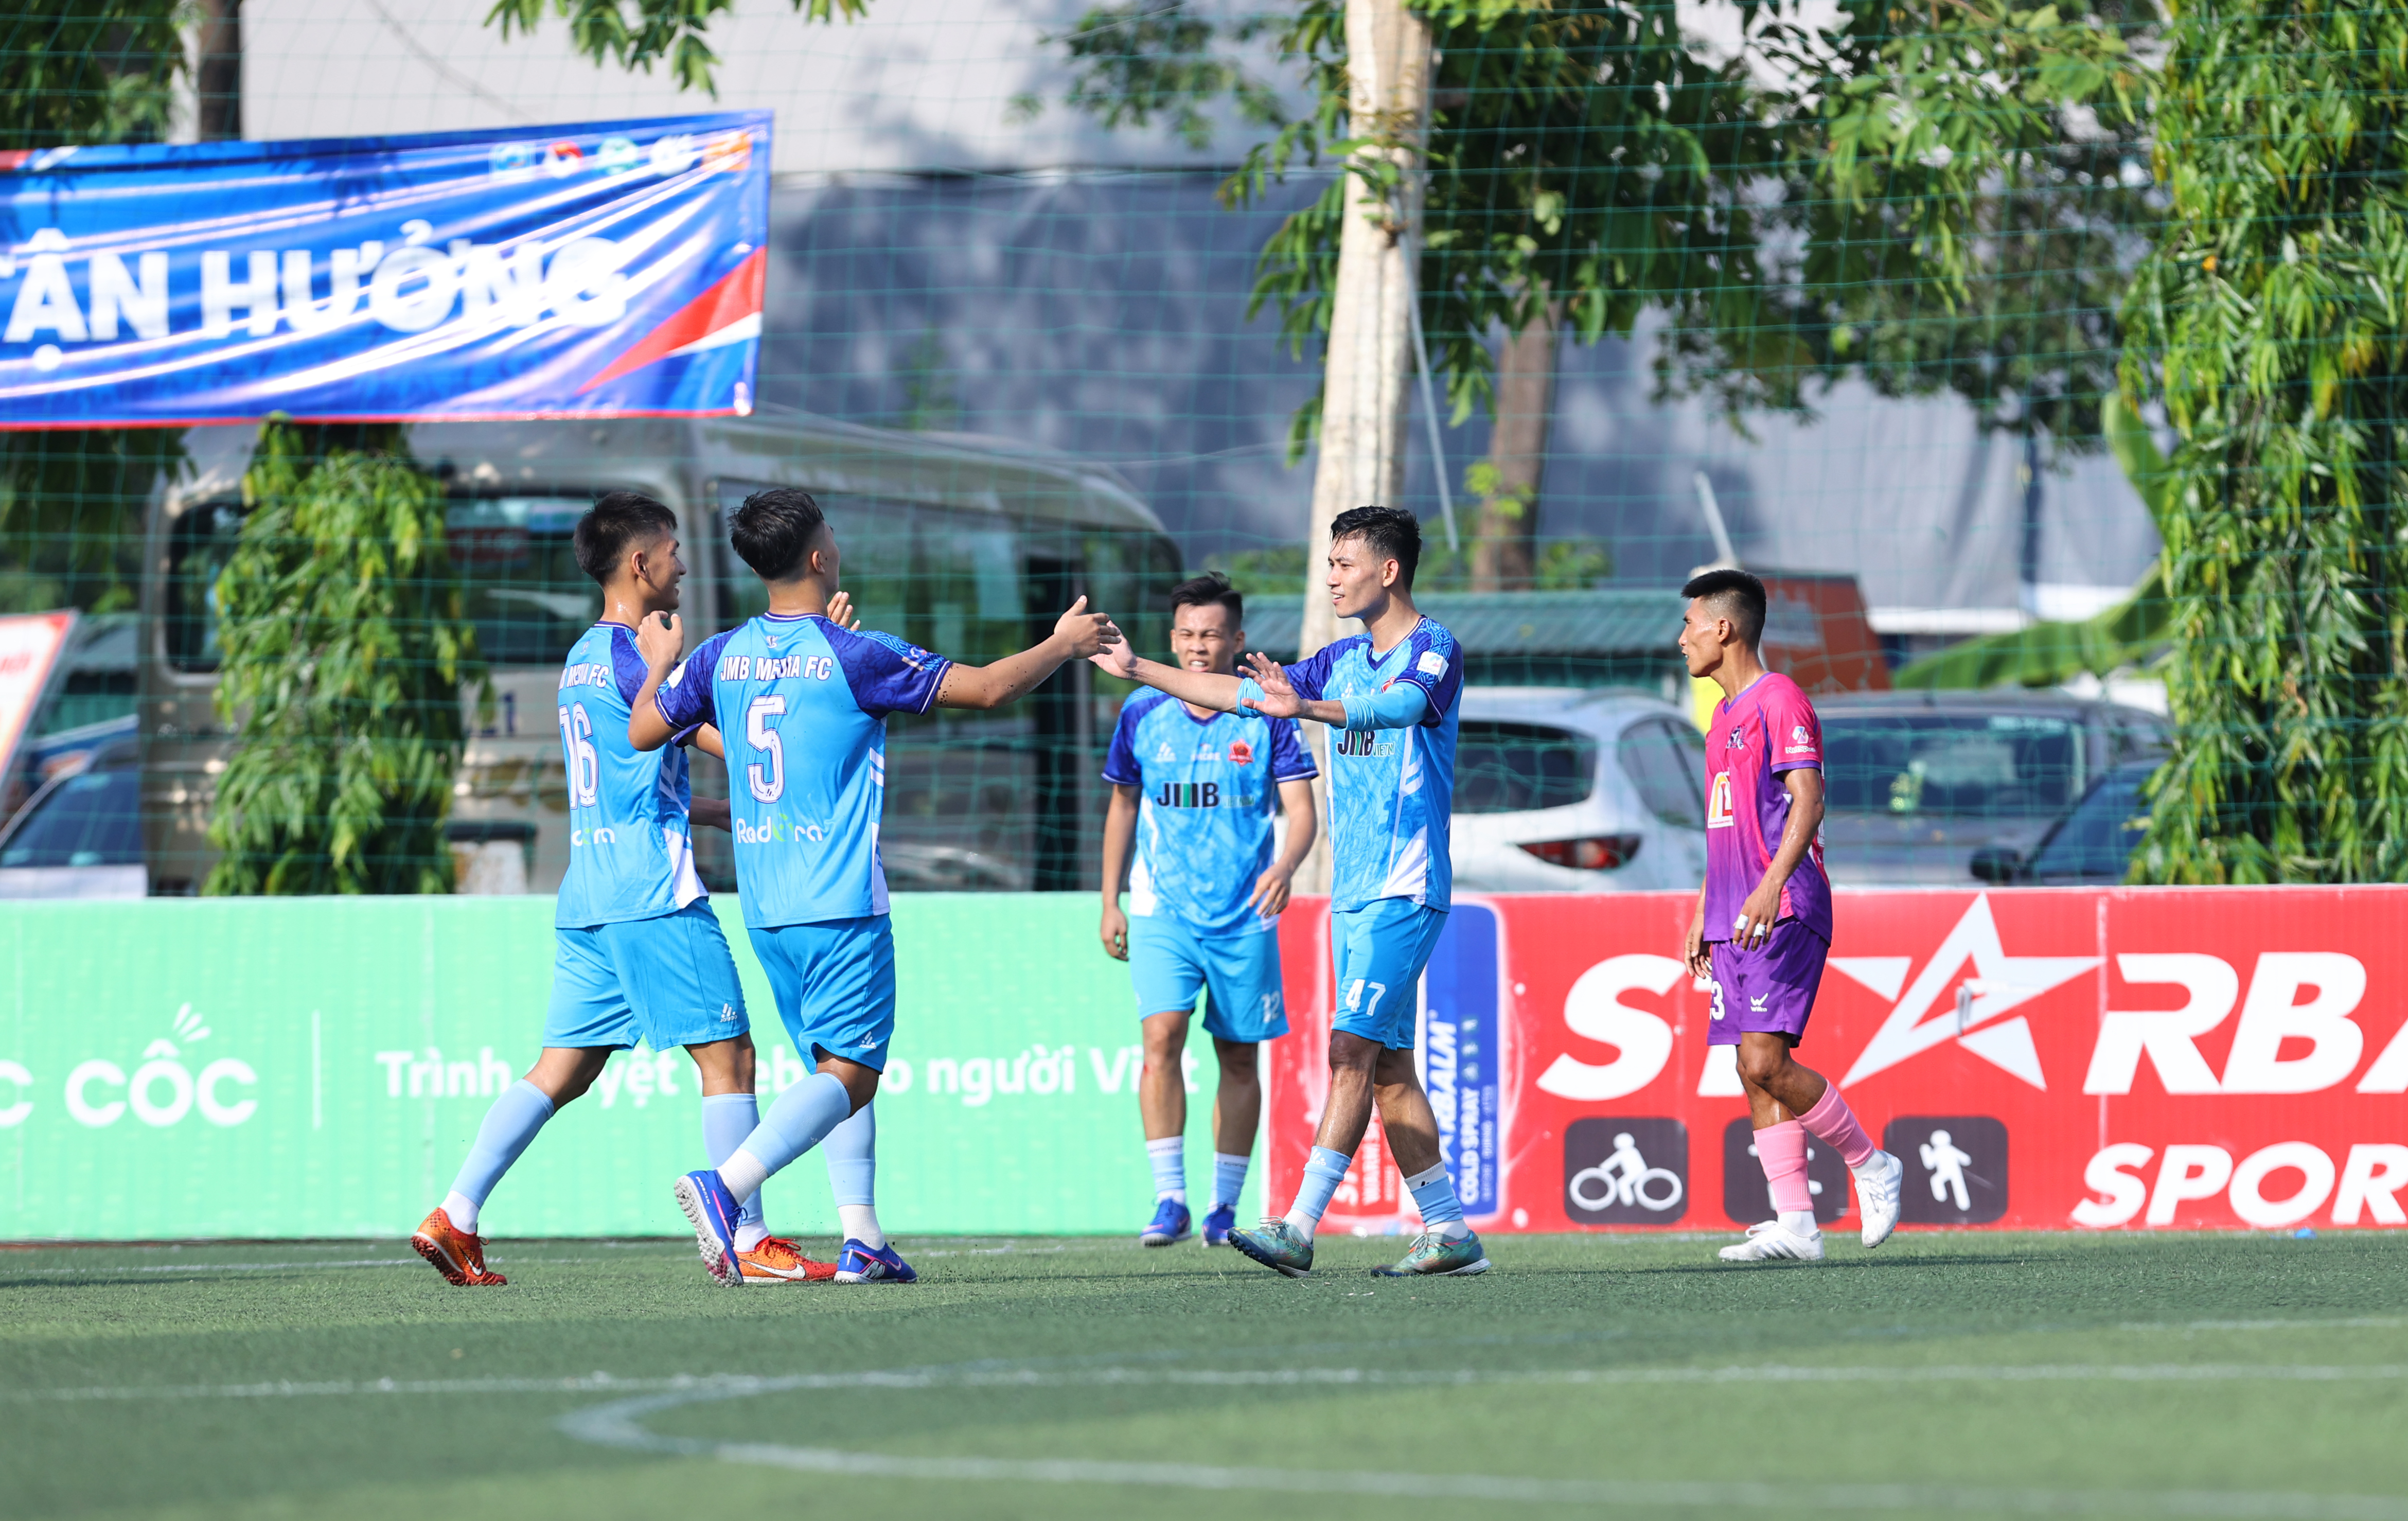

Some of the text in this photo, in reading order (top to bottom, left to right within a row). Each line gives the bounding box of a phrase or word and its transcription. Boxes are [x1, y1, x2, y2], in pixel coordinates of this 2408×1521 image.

[0, 228, 170, 372] ẬN
[587, 663, 610, 688] FC
[720, 656, 751, 682] JMB
[803, 655, 833, 681] FC
[746, 694, 787, 804] 5
[1345, 978, 1387, 1017] 47
[1709, 980, 1726, 1021] 3
[375, 1046, 512, 1098] Trình
[927, 1044, 1075, 1106] người
[1089, 1045, 1200, 1094] Vit
[1459, 1086, 1480, 1206] COLD SPRAY
